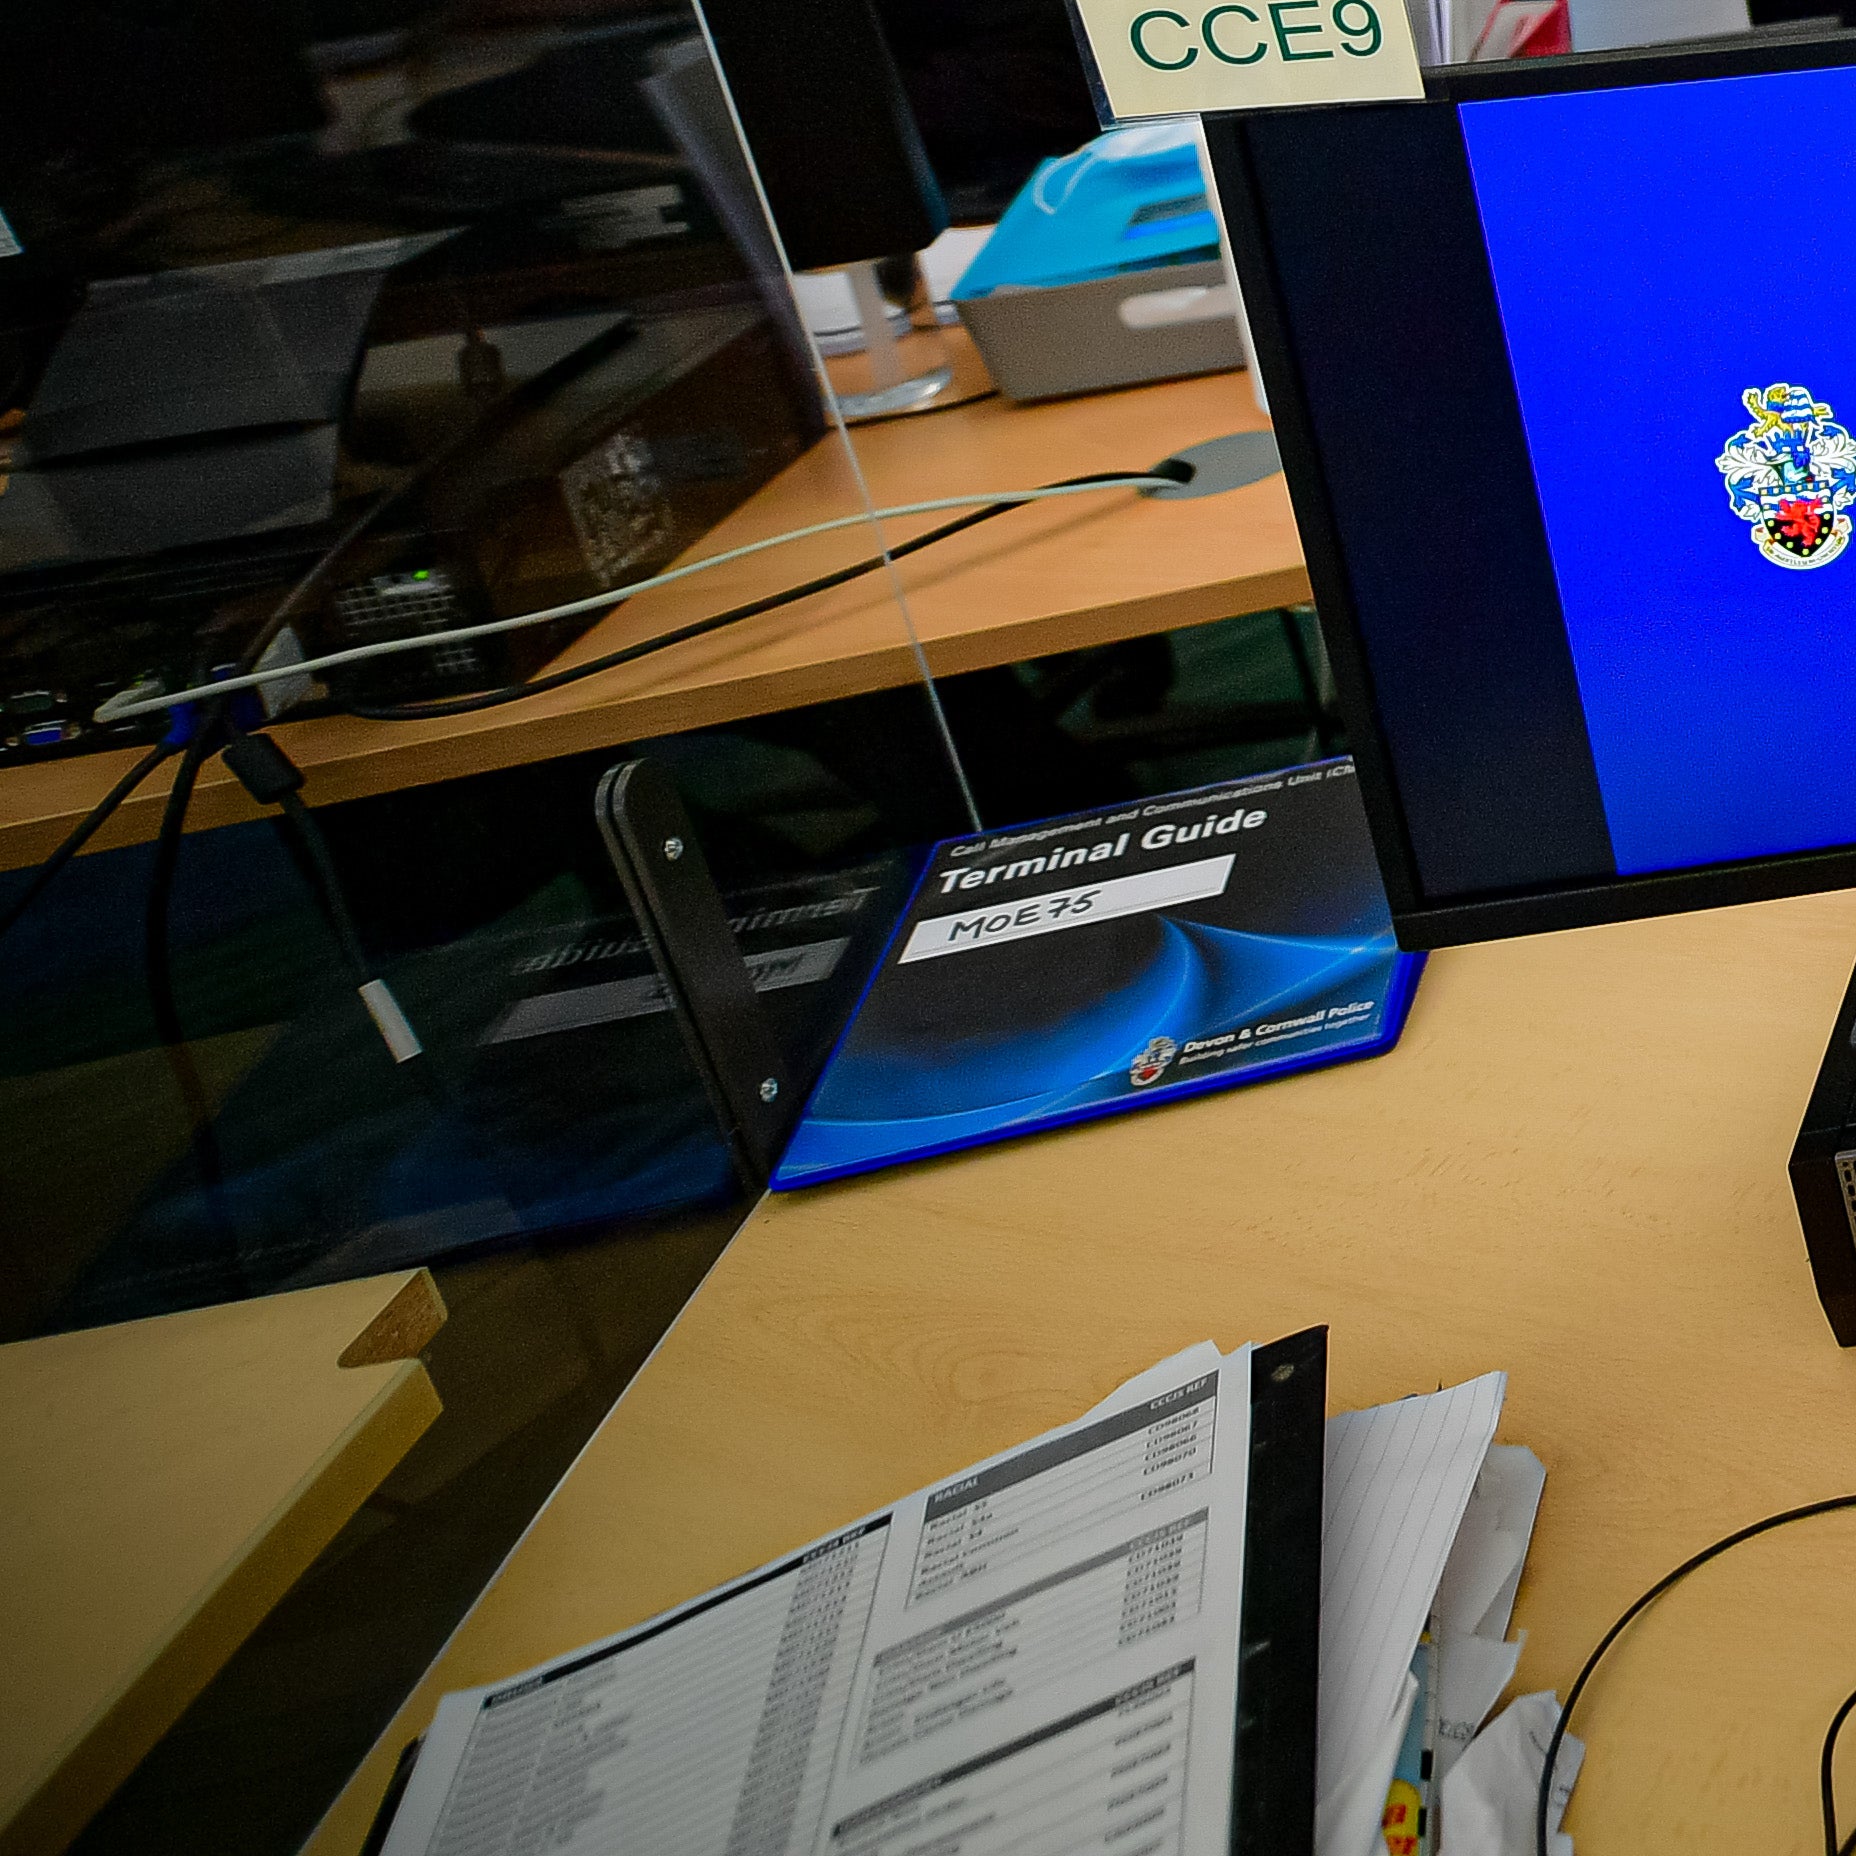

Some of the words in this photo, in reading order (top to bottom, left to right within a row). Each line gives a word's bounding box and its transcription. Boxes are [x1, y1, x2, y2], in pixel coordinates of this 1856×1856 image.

[988, 818, 1102, 849] Management
[1105, 808, 1139, 825] and
[1143, 781, 1282, 817] Communications
[940, 833, 1130, 894] Terminal
[1141, 808, 1268, 851] Guide
[949, 890, 1103, 942] MOE75
[1183, 1034, 1234, 1053] Devon
[1239, 1028, 1251, 1040] &
[1255, 1011, 1325, 1036] Cornwall
[1328, 1000, 1375, 1019] Police
